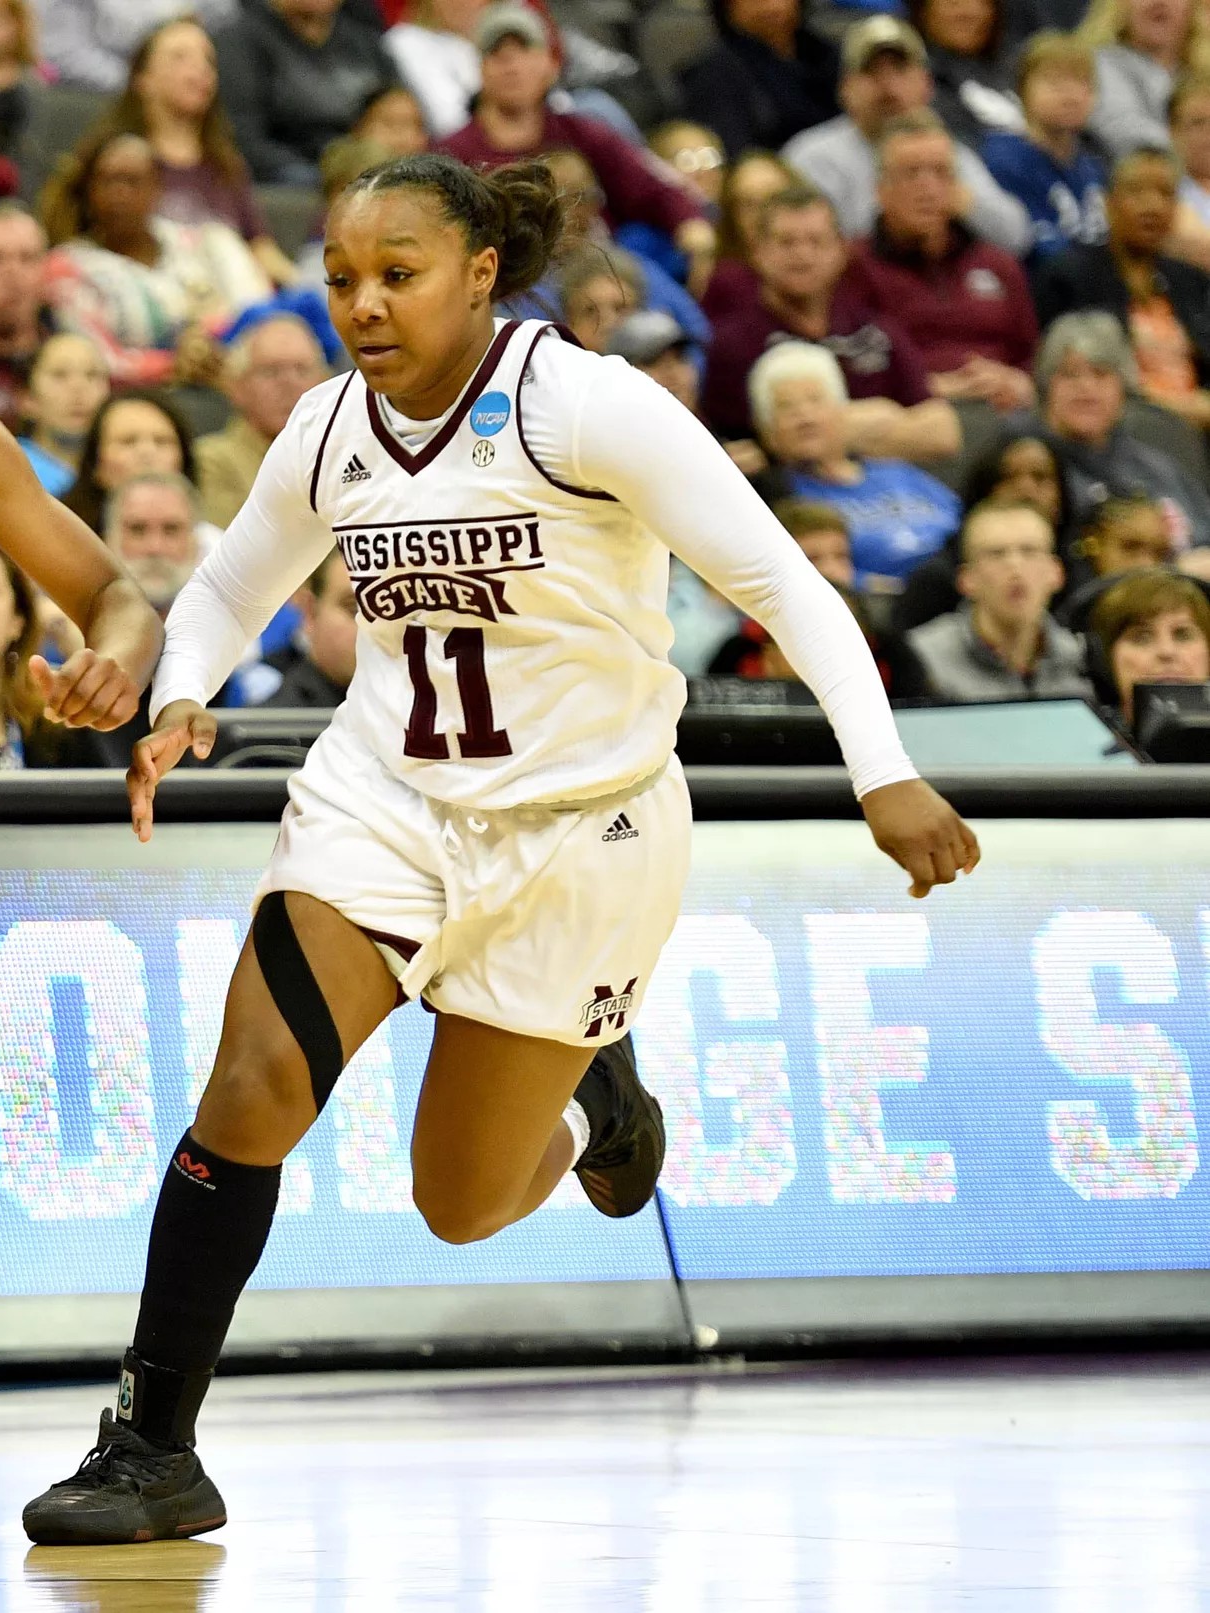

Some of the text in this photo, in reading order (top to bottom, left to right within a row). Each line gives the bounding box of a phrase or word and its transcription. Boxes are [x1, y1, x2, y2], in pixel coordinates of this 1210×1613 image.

[341, 470, 372, 484] adidas
[374, 577, 482, 617] STATE
[402, 623, 514, 761] 11
[601, 829, 640, 842] adidas
[591, 995, 630, 1020] STATE
[1032, 908, 1210, 1201] S
